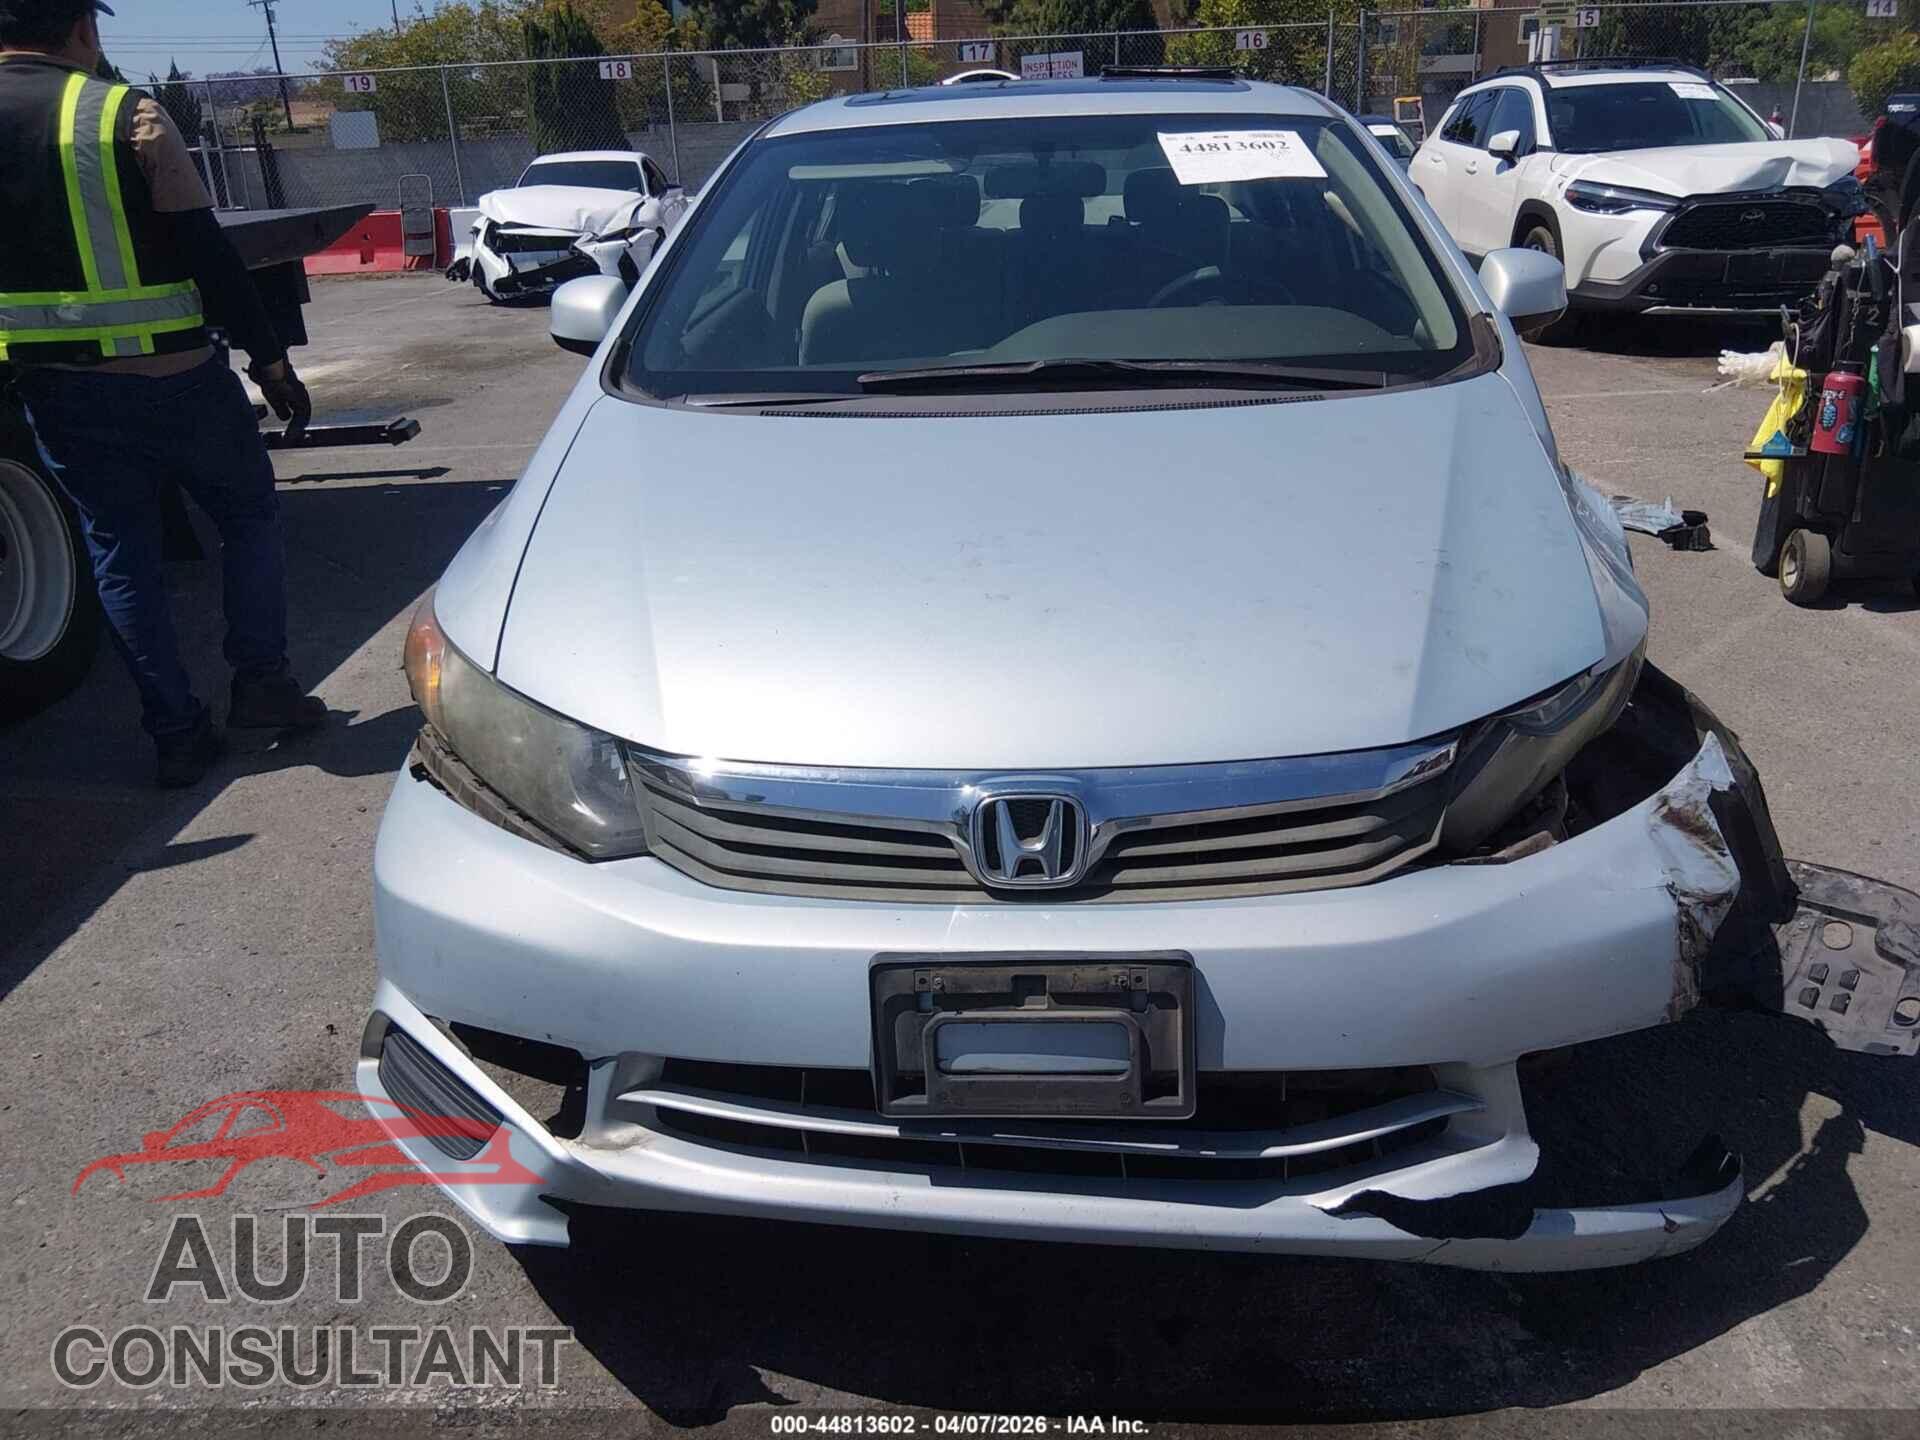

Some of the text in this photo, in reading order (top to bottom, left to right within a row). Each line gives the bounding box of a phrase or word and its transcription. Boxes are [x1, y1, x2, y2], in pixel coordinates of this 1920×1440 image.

[1873, 0, 1892, 15] 14
[1576, 12, 1594, 26] 15
[1243, 33, 1262, 48] 16
[969, 44, 989, 60] 17
[606, 63, 625, 78] 18
[350, 76, 370, 91] 19
[1179, 140, 1291, 153] 44813602
